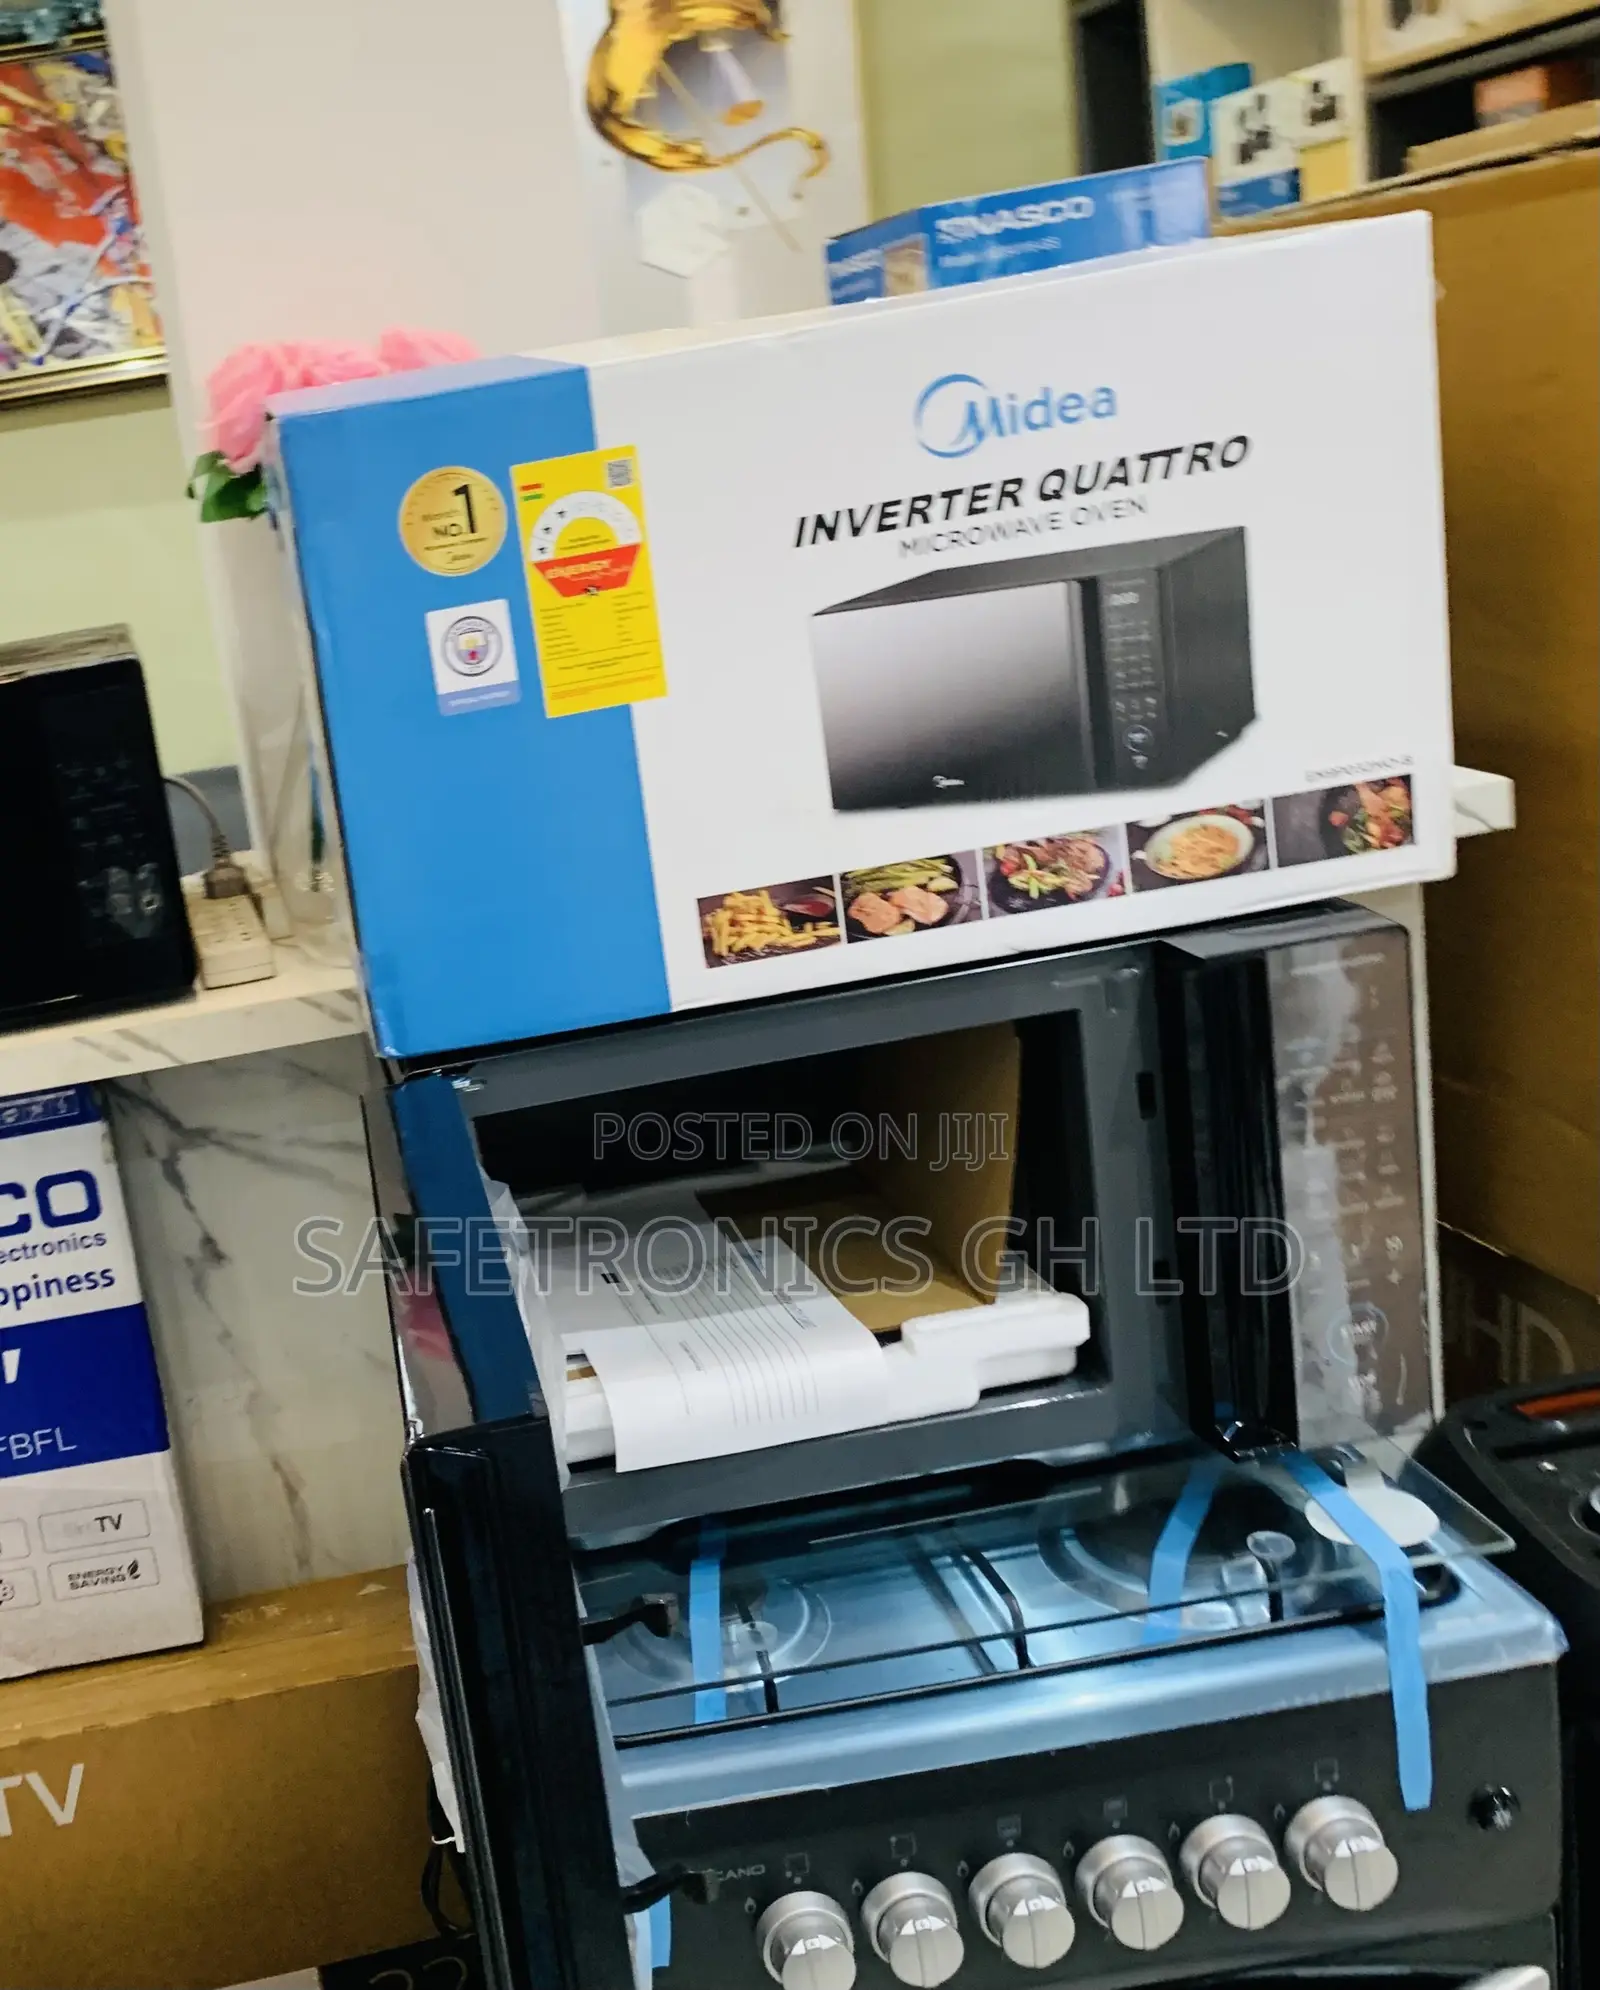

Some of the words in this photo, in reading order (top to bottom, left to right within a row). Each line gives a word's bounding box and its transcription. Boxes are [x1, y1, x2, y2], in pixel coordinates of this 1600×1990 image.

[914, 374, 1117, 458] Midea
[794, 476, 1024, 548] INVERTER
[1038, 434, 1252, 502] QUATTRO
[899, 510, 1062, 557] MICROWAVE
[1073, 495, 1147, 526] OVEN
[67, 1564, 124, 1583] ENERGY
[69, 1572, 127, 1592] SAVING
